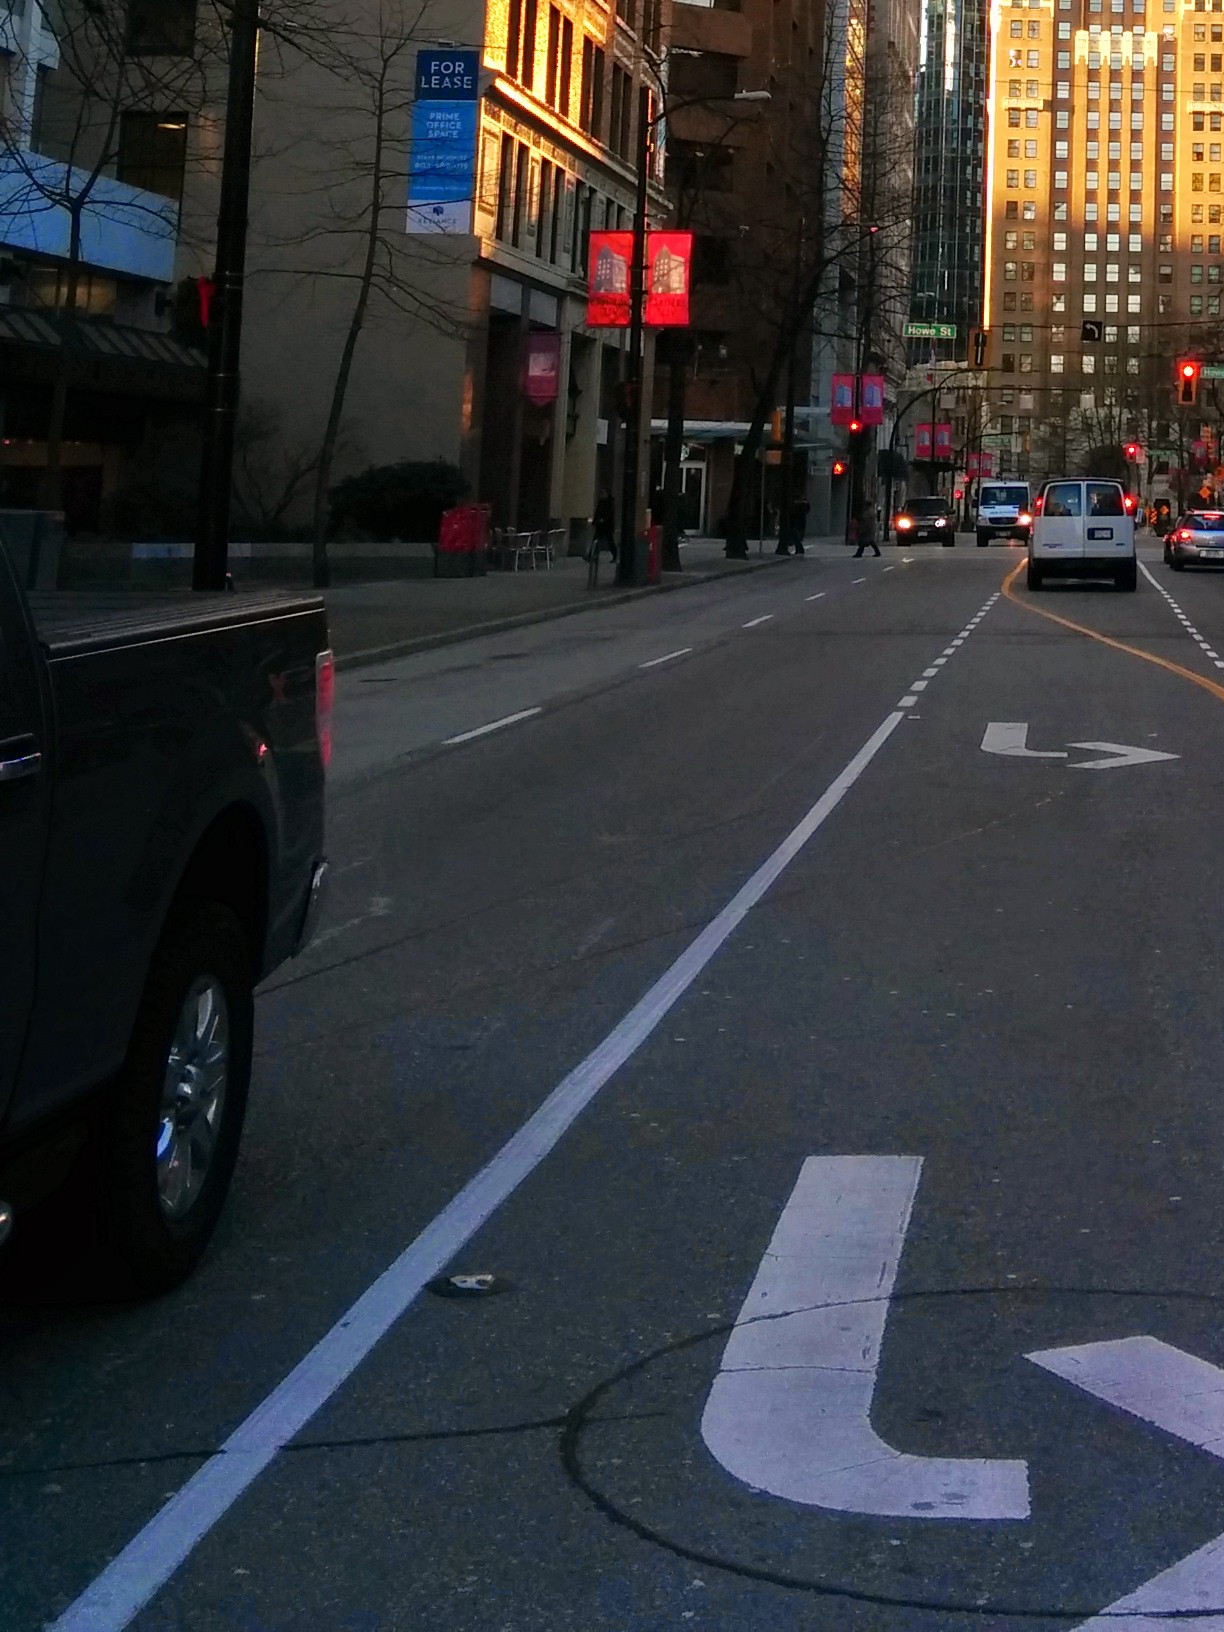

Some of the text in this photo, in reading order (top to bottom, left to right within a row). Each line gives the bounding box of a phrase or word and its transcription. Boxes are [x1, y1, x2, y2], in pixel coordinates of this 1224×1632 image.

[430, 61, 465, 74] FOR
[421, 76, 472, 89] LEASE
[429, 112, 460, 121] PRIME
[426, 121, 462, 130] OFFICE
[427, 129, 459, 138] SPACE
[908, 325, 952, 336] Howe St
